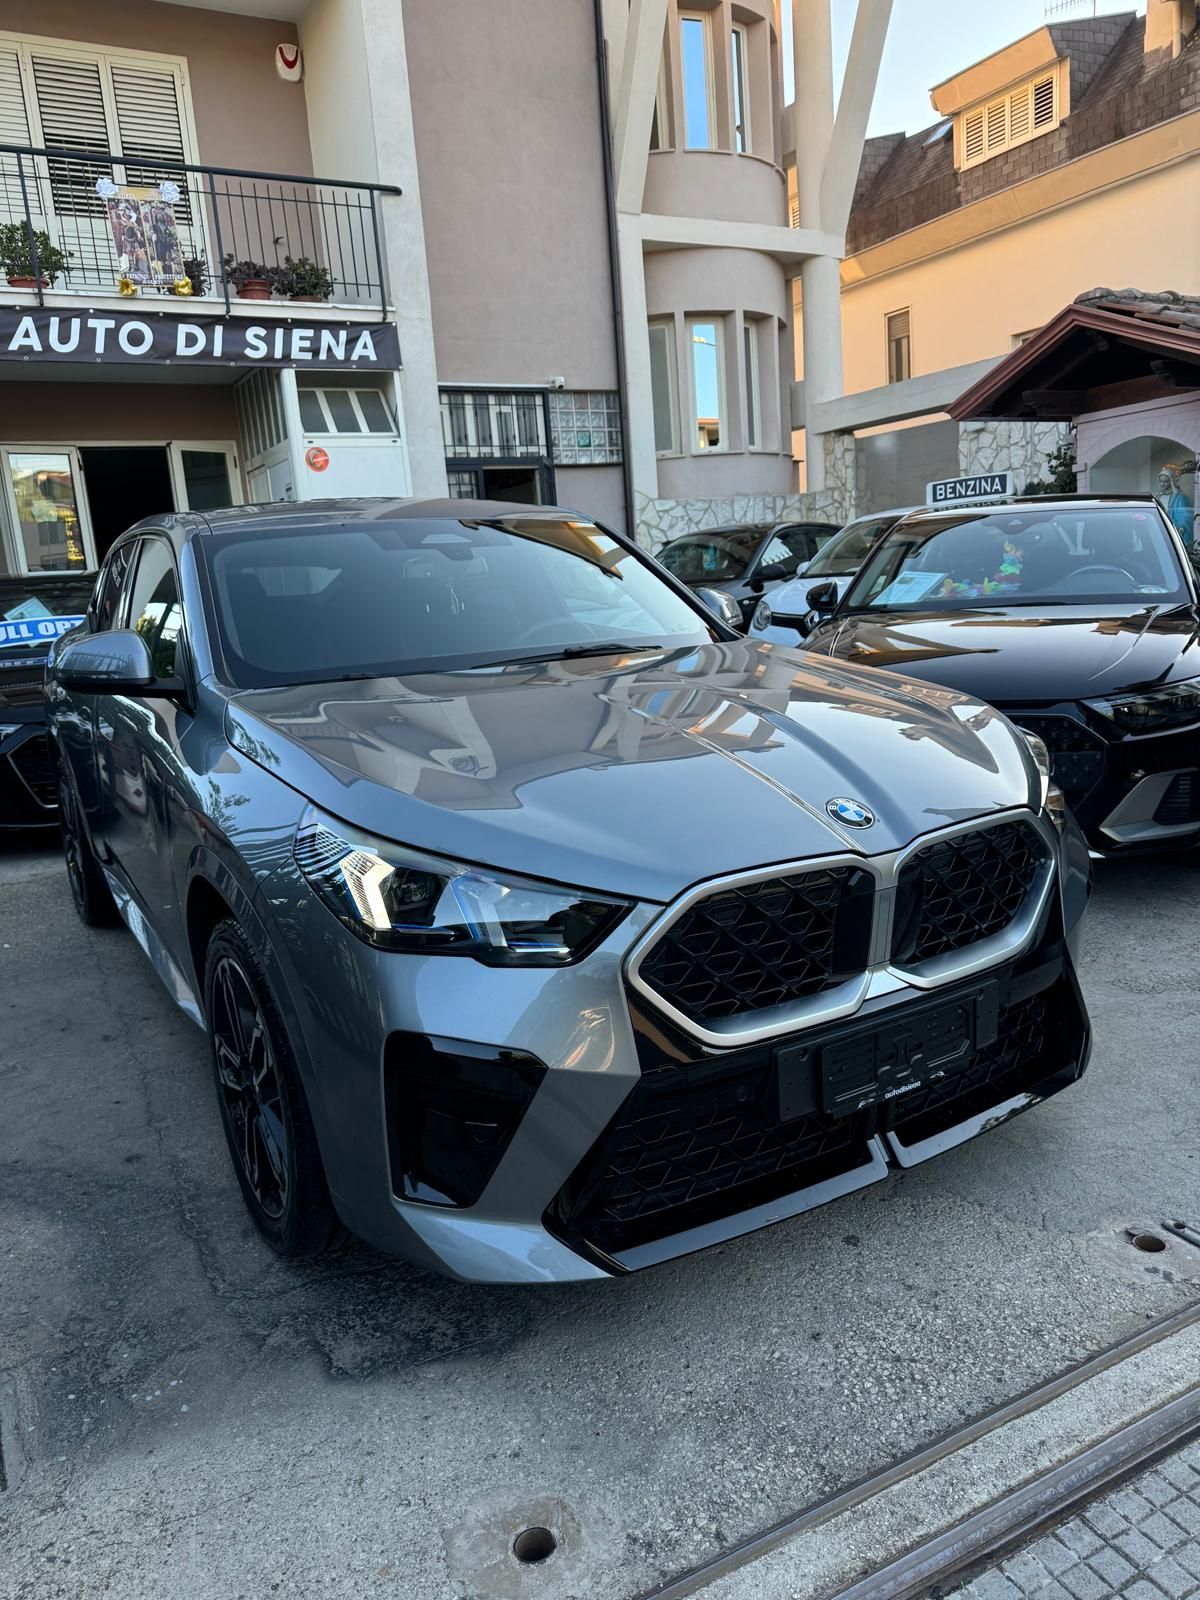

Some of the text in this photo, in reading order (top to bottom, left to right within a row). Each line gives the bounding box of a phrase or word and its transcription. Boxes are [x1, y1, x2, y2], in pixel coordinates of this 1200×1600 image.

[8, 316, 378, 361] AUTO DI SIENA
[936, 477, 1002, 500] BENZINA
